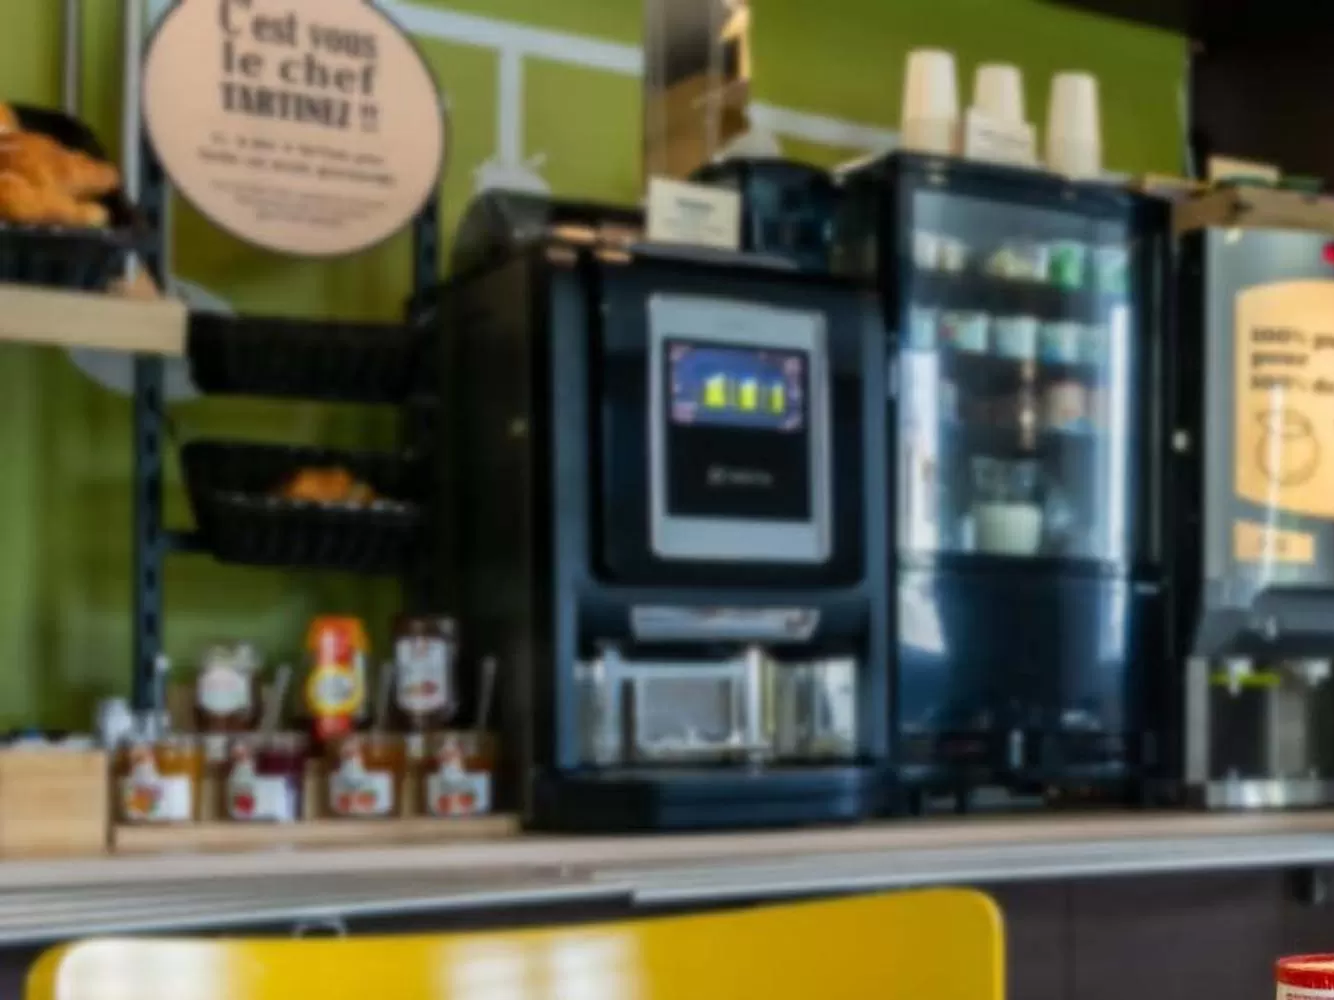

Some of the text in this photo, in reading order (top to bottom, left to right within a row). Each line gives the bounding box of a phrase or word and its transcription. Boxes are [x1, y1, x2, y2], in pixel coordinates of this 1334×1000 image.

[307, 24, 378, 58] vous
[221, 39, 377, 95] le chef
[218, 81, 351, 129] TARTINEZ
